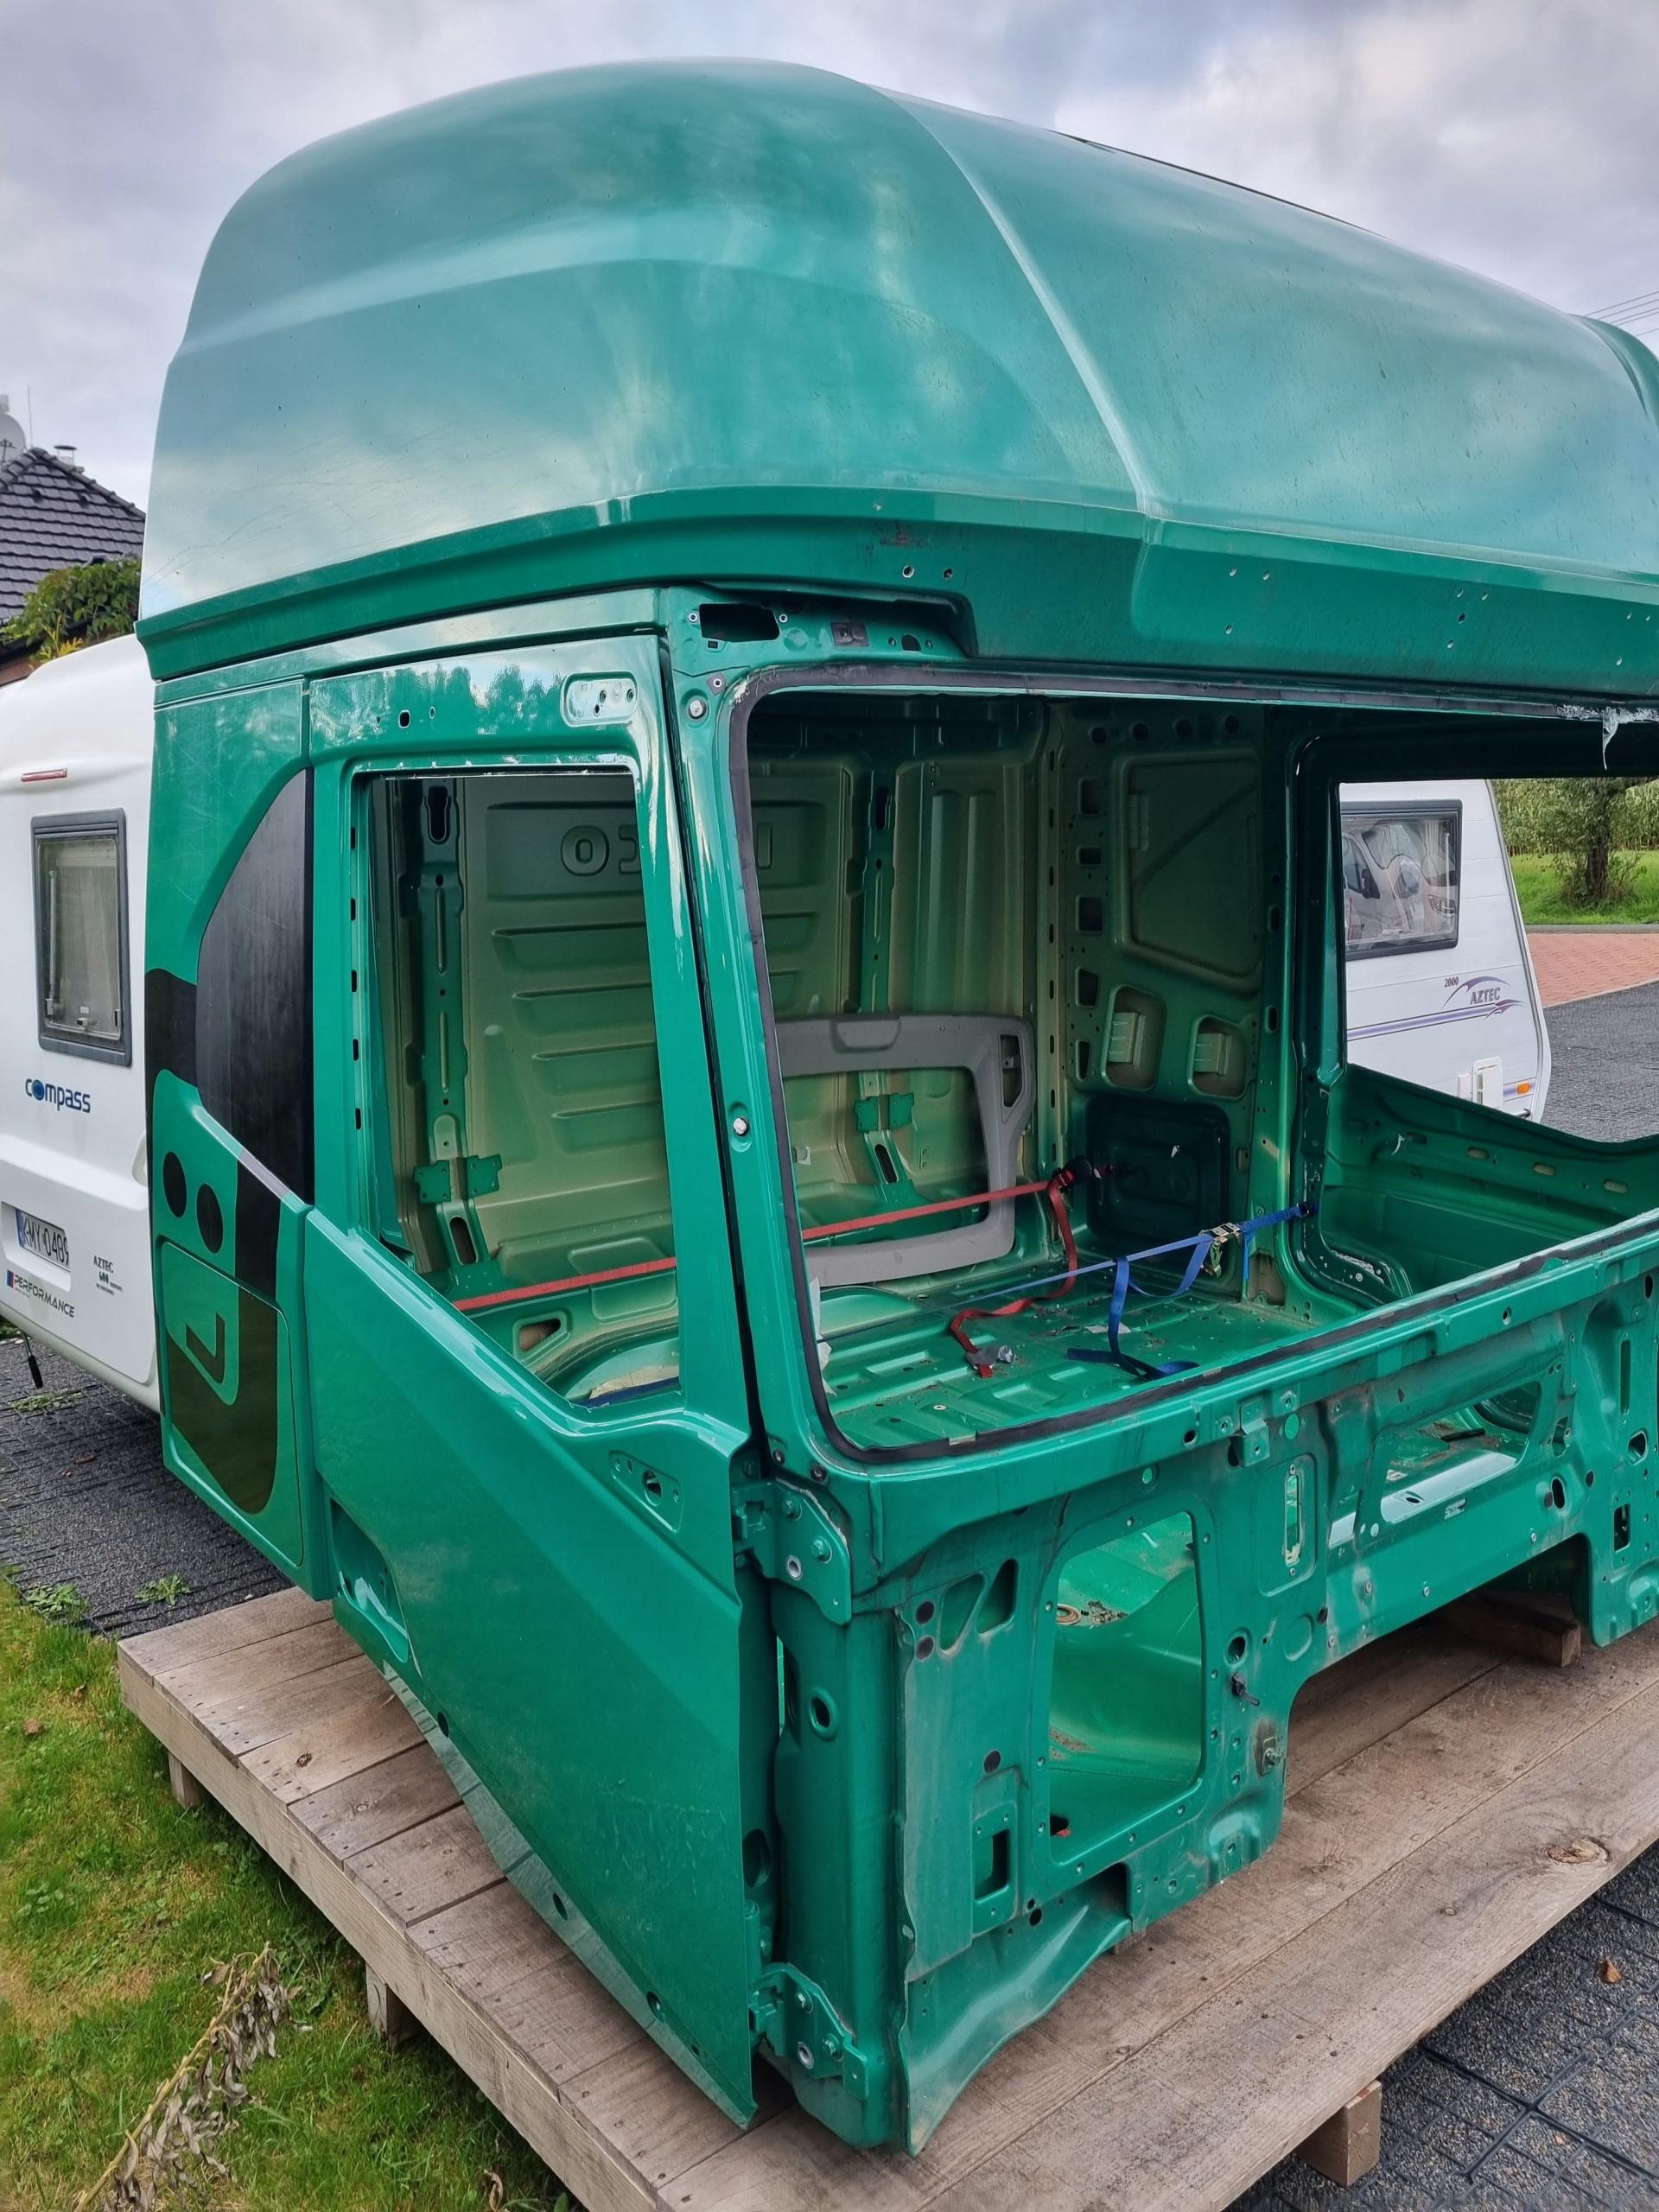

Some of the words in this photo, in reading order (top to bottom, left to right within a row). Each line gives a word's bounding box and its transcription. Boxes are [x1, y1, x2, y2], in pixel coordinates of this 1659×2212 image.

[1444, 976, 1459, 988] 2000
[1470, 987, 1501, 1005] AZTEC
[25, 1078, 91, 1113] compass
[93, 1255, 114, 1274] AZTEC
[15, 1274, 75, 1318] PERFORMANCE
